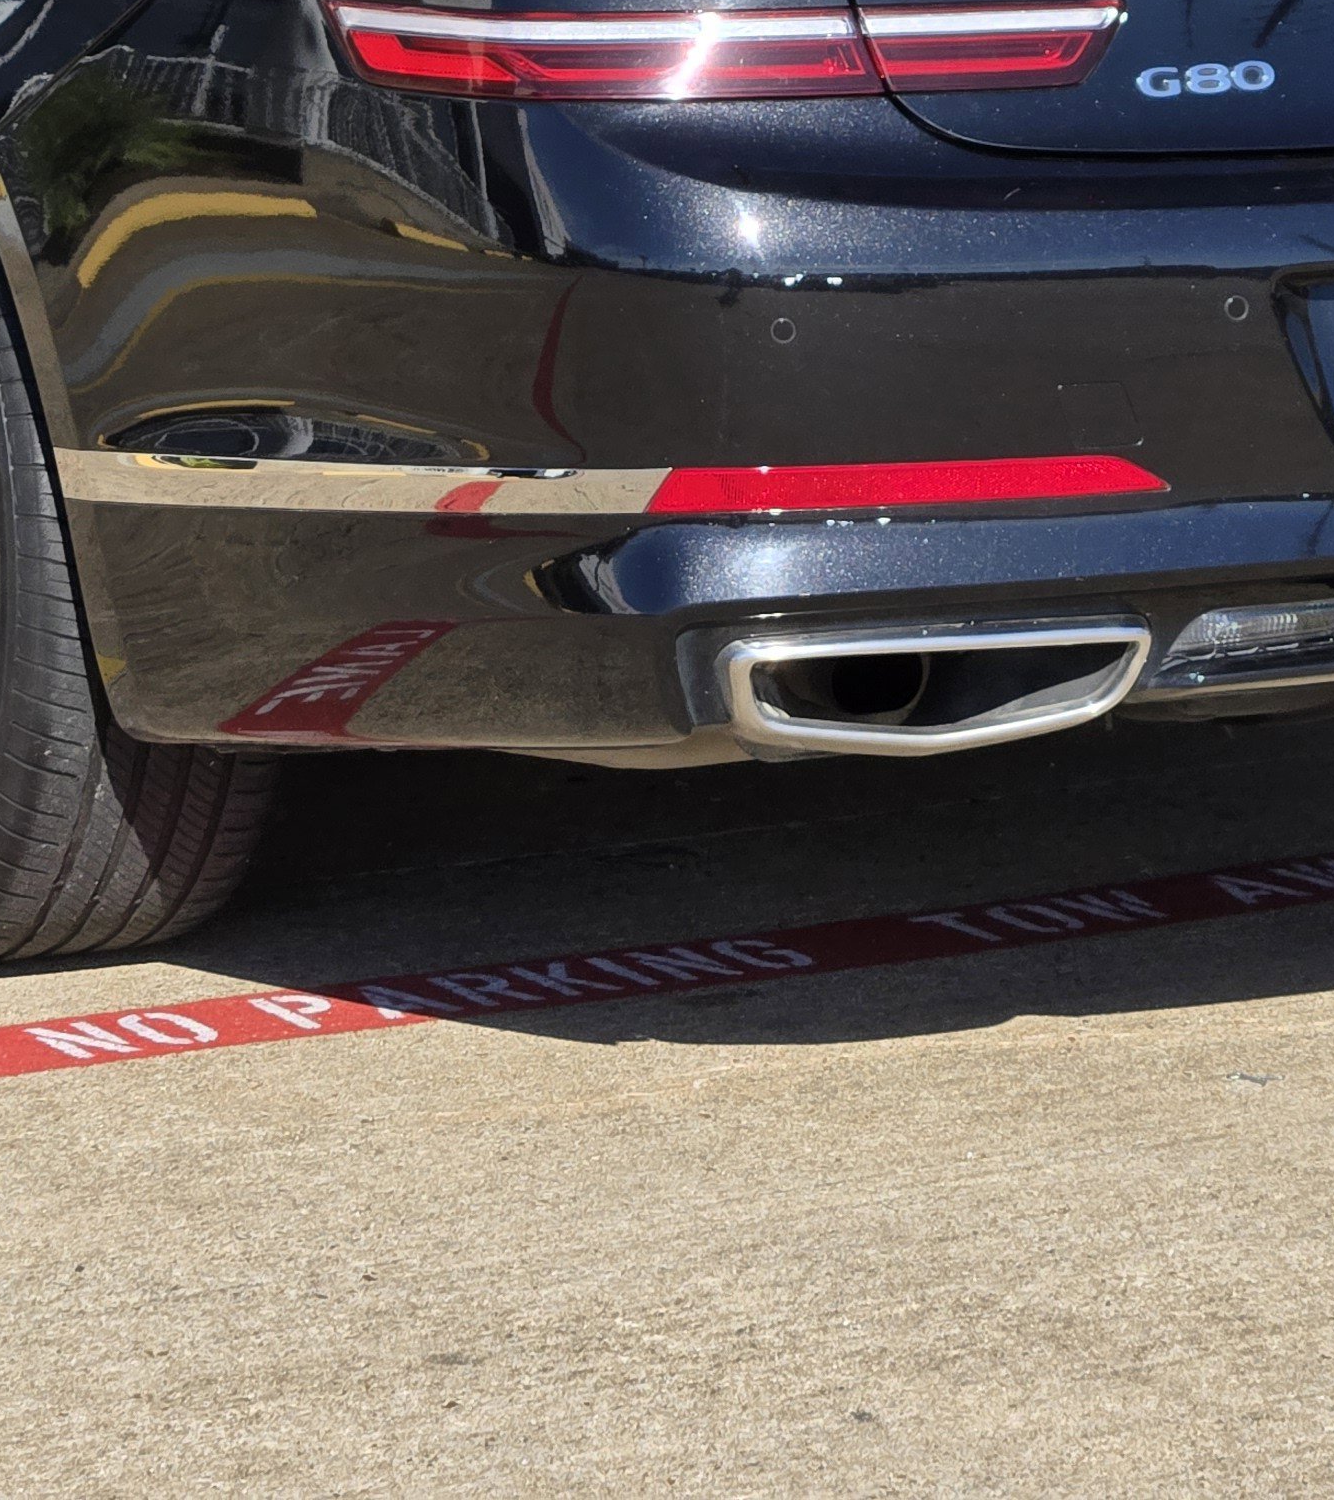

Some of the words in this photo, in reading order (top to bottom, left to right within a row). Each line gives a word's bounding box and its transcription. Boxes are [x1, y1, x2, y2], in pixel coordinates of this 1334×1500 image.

[1135, 59, 1276, 99] G80
[24, 1013, 218, 1059] NO
[252, 939, 813, 1030] PARKING
[908, 889, 1169, 943] TOW
